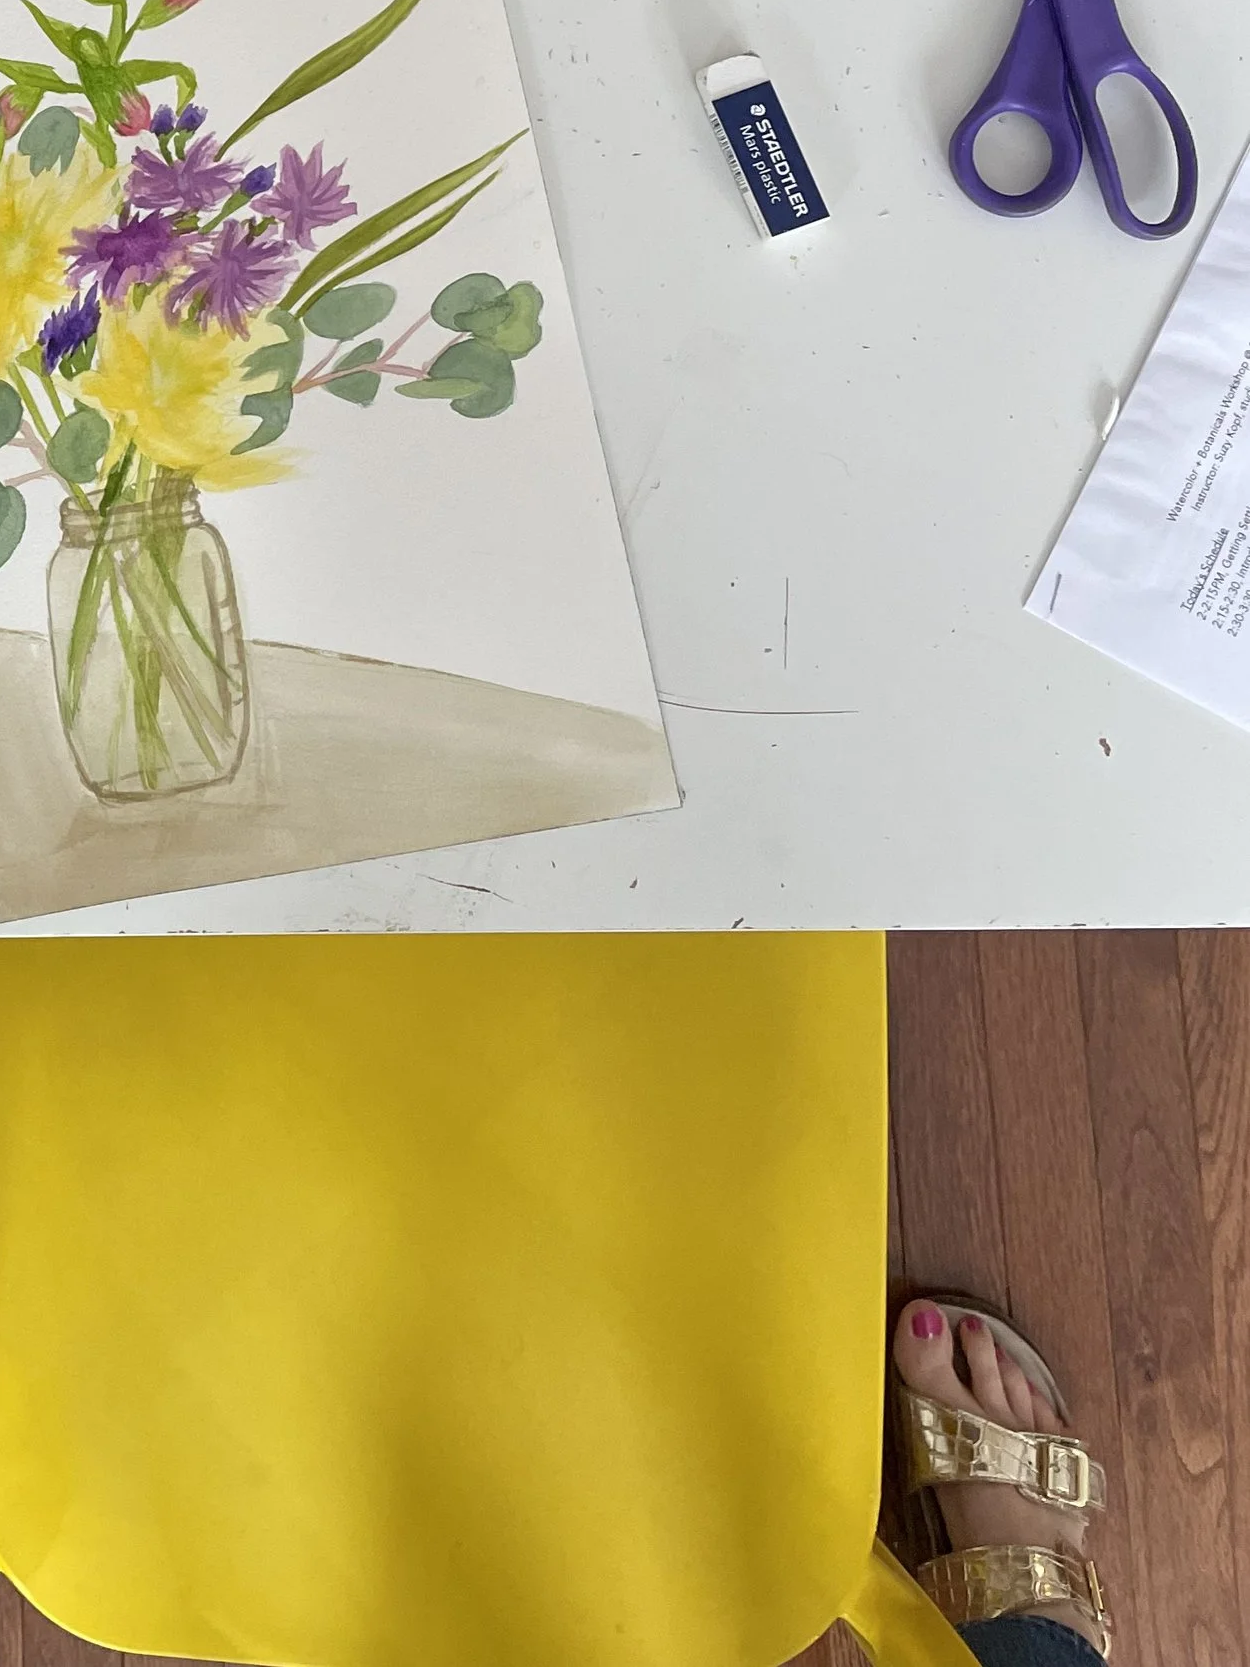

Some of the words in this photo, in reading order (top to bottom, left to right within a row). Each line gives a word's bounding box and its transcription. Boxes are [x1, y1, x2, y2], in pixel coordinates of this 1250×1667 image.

[739, 124, 761, 159] Mars
[752, 158, 783, 205] plastic
[756, 118, 809, 218] STAEDTLER
[1166, 468, 1199, 522] Watercolor
[1197, 410, 1227, 459] Botanicals
[1219, 361, 1250, 408] Workshop
[1190, 463, 1220, 512] Instructor:
[1213, 439, 1233, 462] Suzy
[1180, 573, 1207, 613] Today's
[1200, 527, 1230, 573] Schedule
[1197, 571, 1229, 621] 2-2:15PM,
[1222, 531, 1246, 568] Getting
[1212, 580, 1243, 629] 2:15-2:30,
